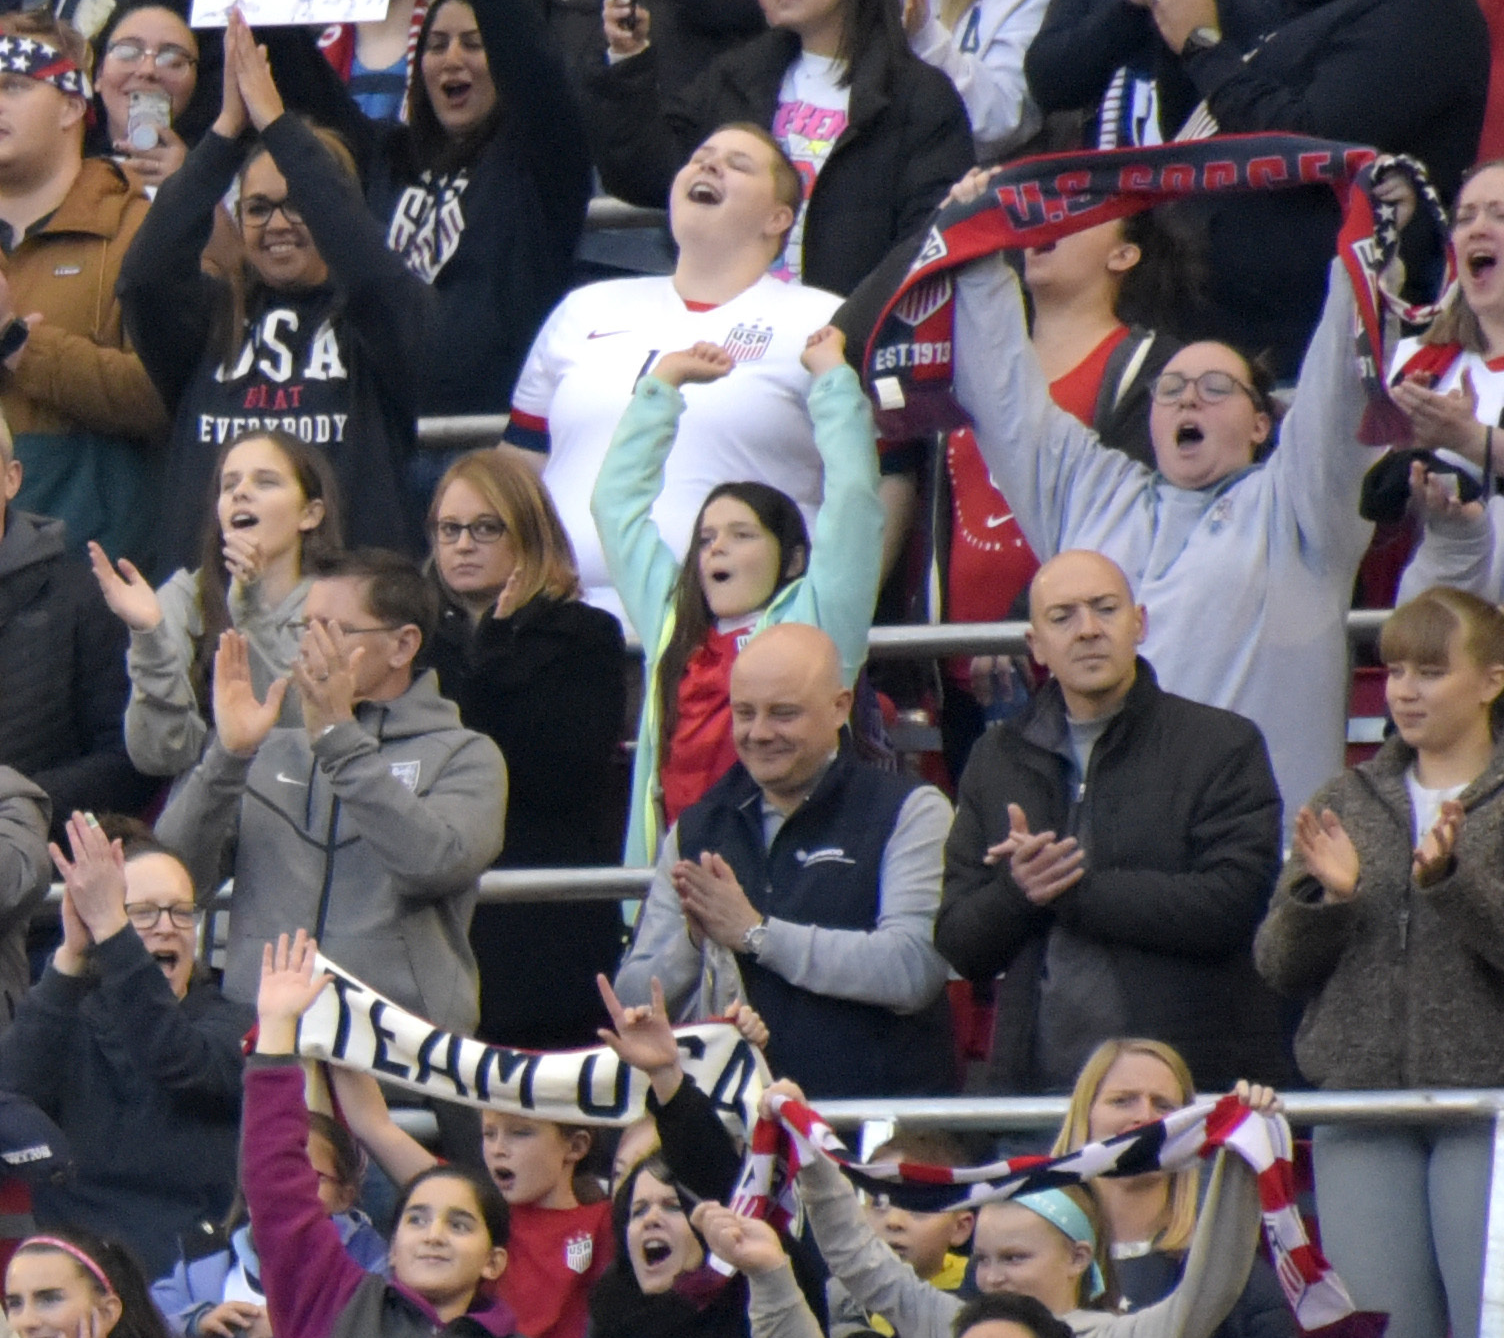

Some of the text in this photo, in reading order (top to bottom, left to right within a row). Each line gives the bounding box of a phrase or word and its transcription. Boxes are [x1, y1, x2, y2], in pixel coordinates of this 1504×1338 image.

[733, 330, 770, 349] USA
[320, 966, 538, 1109] TEAM
[569, 1242, 592, 1256] USA
